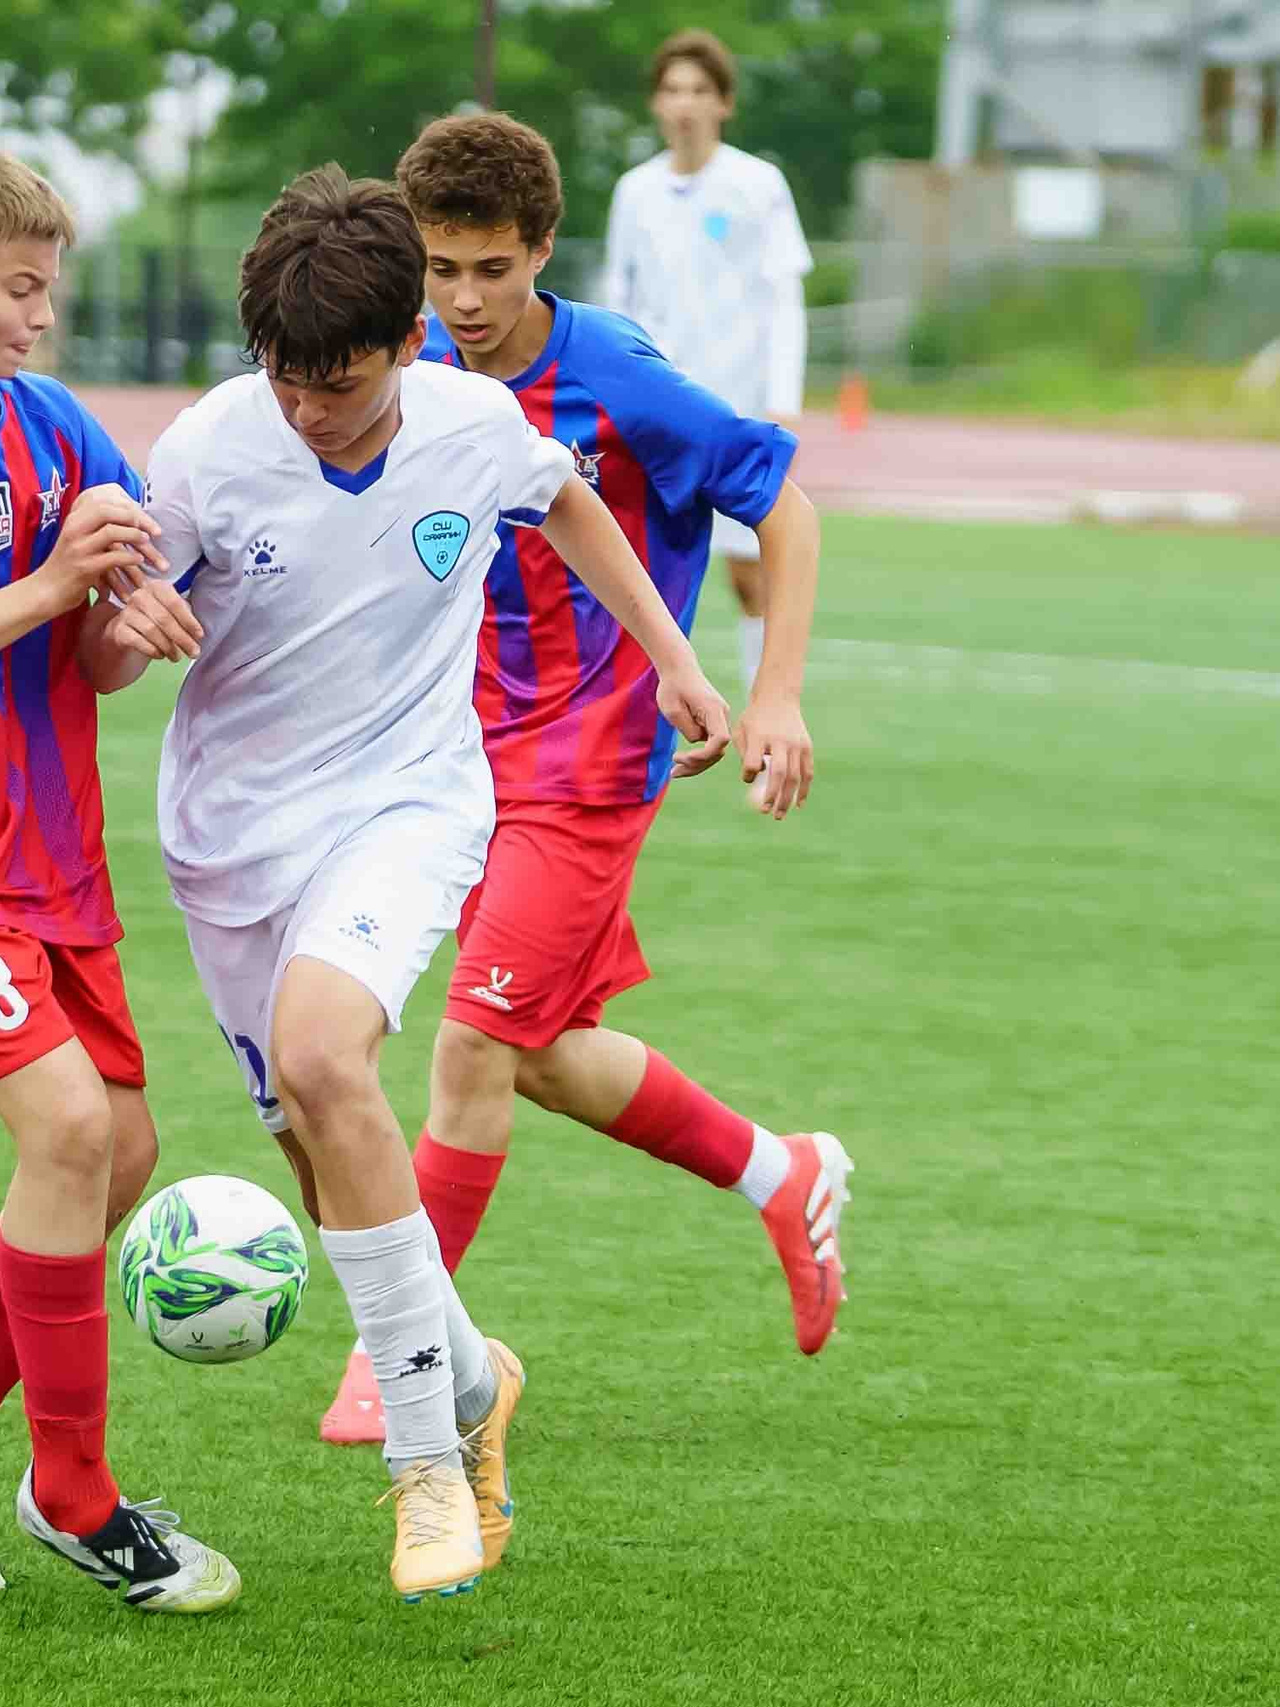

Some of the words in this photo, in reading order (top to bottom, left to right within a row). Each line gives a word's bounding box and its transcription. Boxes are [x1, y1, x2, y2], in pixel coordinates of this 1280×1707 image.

[432, 520, 453, 532] СШ
[422, 529, 462, 542] САХАЛИН
[242, 565, 289, 578] KELME
